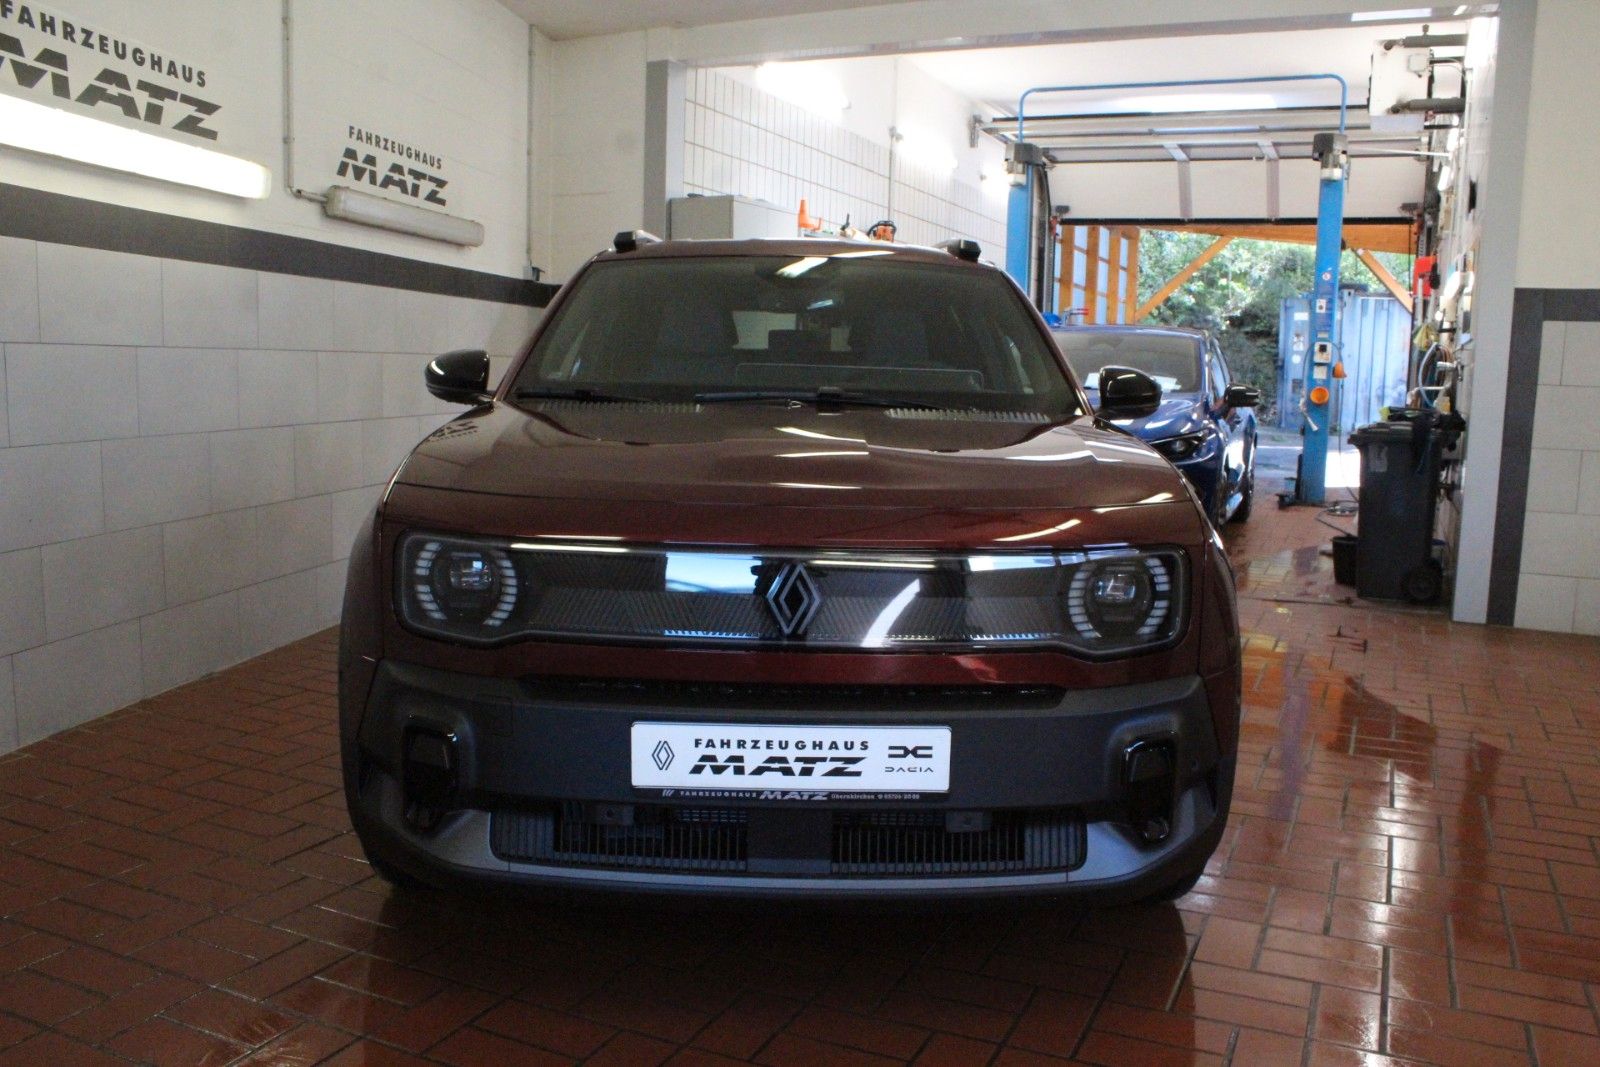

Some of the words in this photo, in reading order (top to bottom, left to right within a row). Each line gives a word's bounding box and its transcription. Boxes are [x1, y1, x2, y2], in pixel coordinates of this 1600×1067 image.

[0, 1, 206, 88] FAHRZEUGHAUS
[0, 32, 222, 141] MATZ
[349, 125, 442, 170] FAHRZEUGHAUS
[336, 147, 448, 206] MATZ
[688, 754, 867, 777] MATZ
[694, 738, 869, 751] FAHRZEUGHAUS
[760, 790, 829, 800] MATZ
